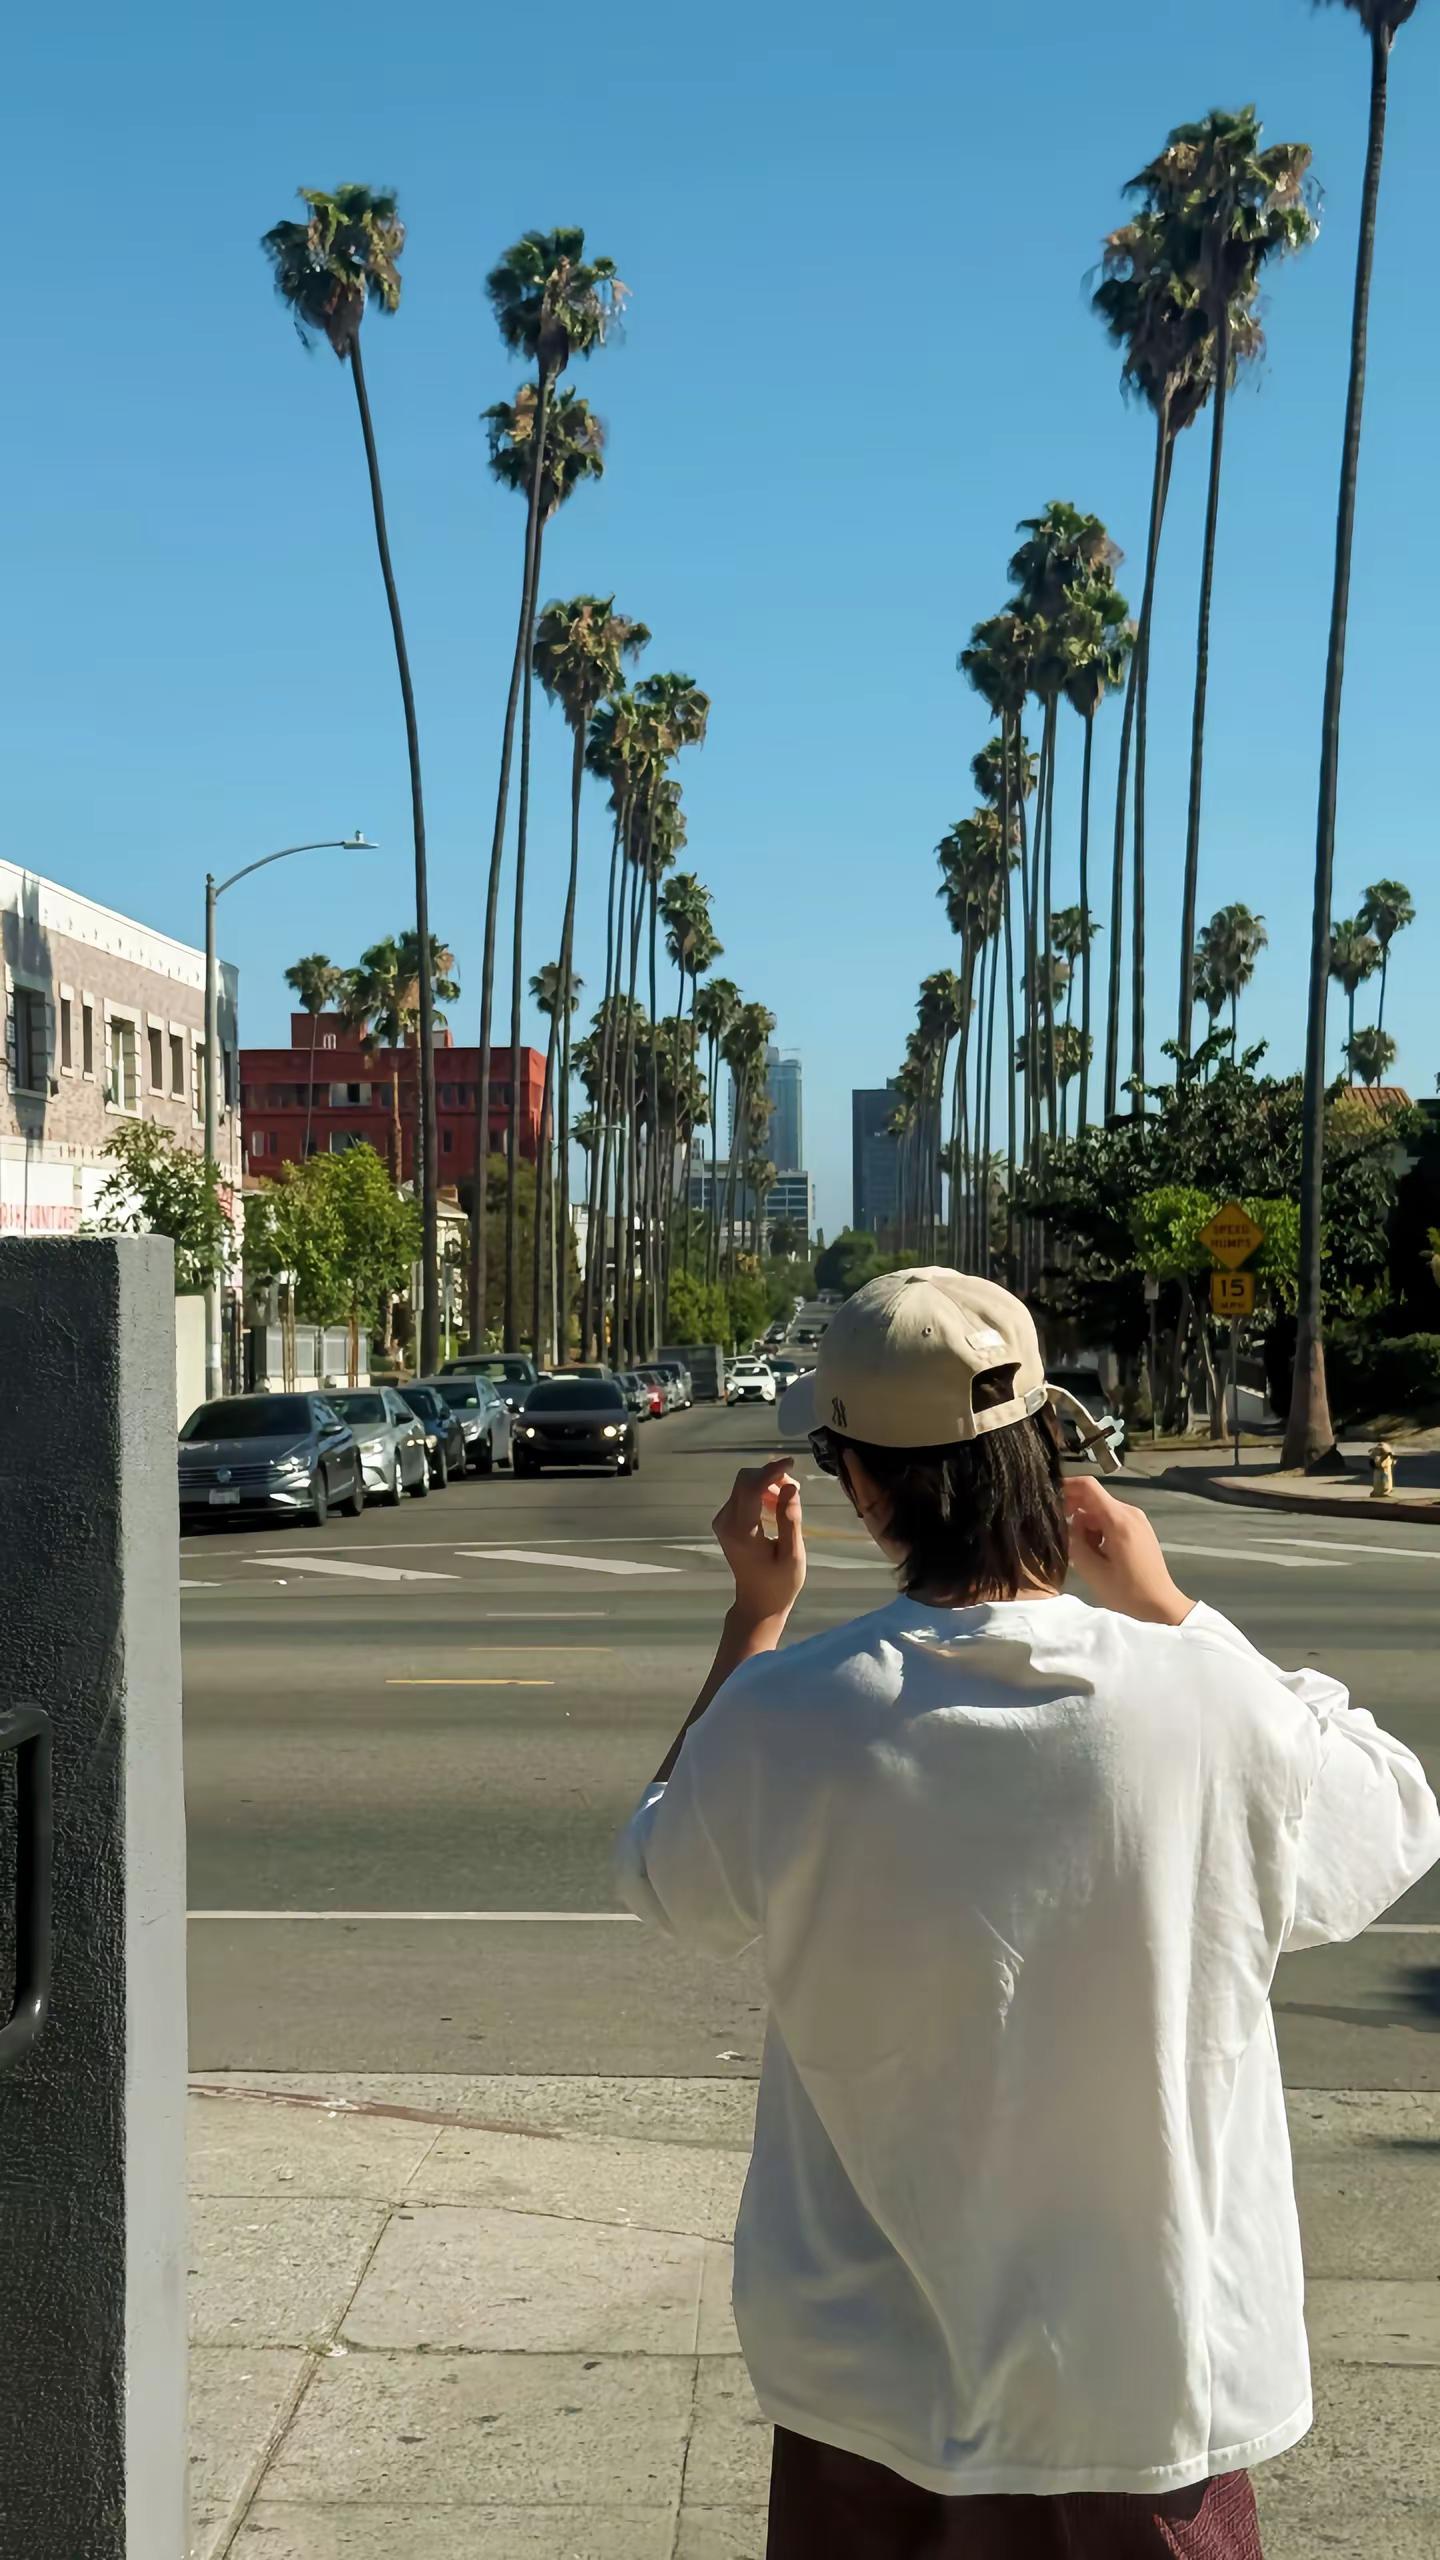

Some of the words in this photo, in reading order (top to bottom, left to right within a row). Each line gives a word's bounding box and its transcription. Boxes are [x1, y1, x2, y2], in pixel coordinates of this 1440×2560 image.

[1214, 1225, 1249, 1234] SPEED
[1211, 1239, 1251, 1248] HUMPS
[1221, 1279, 1245, 1297] 15
